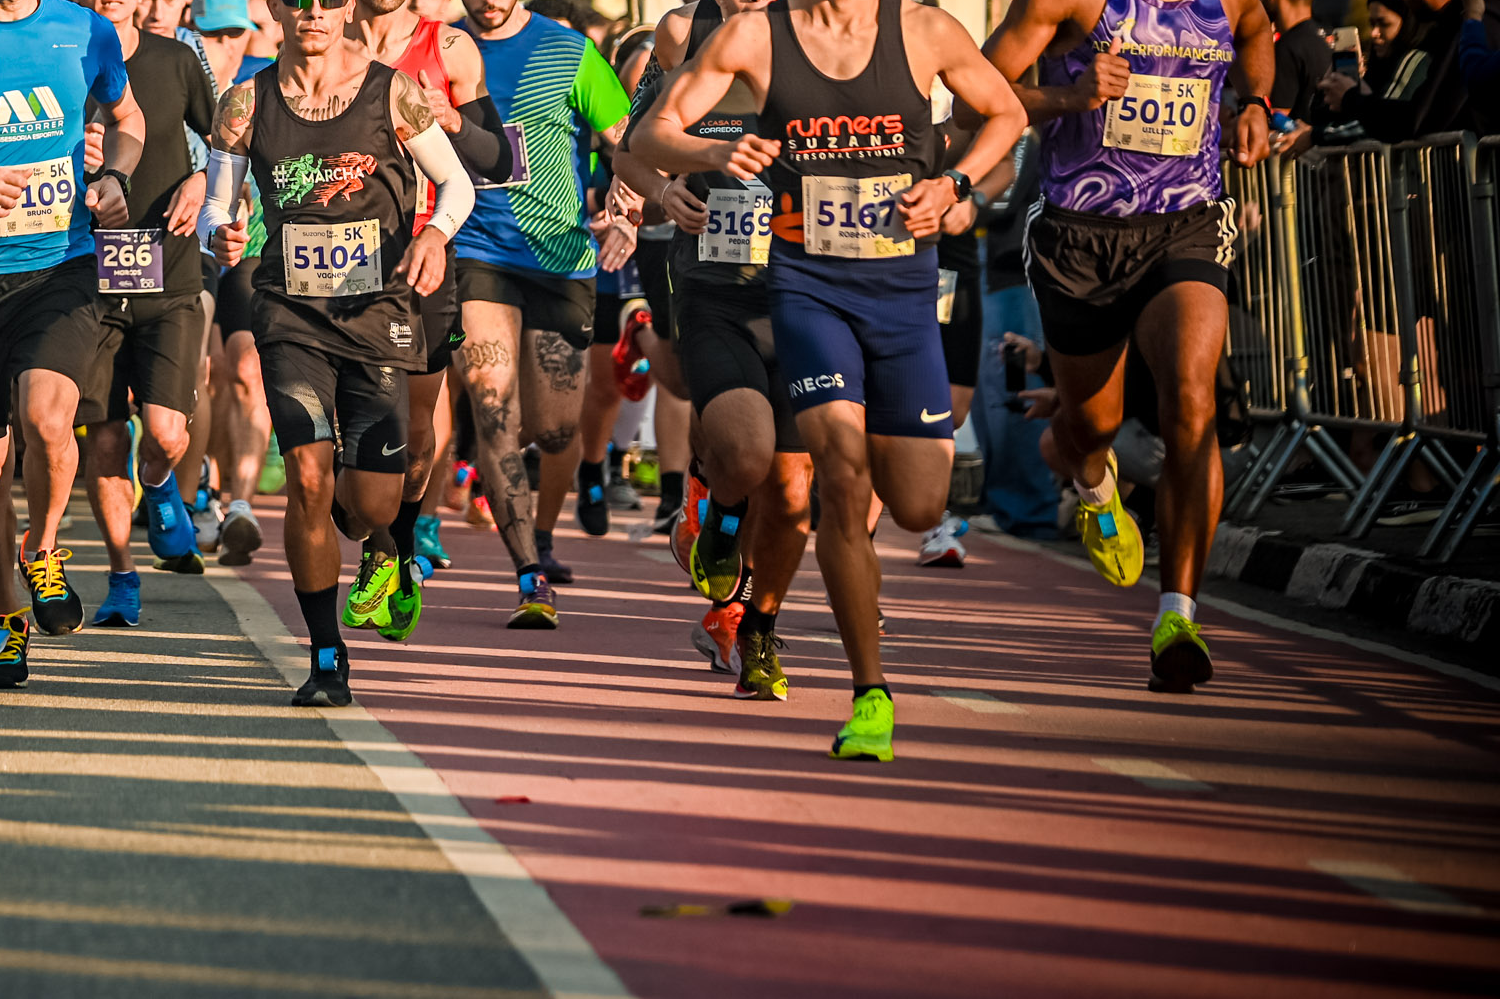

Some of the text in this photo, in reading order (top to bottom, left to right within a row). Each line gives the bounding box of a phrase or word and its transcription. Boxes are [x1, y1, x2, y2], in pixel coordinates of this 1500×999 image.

[1176, 83, 1195, 98] 5K
[1118, 95, 1197, 127] 5010
[699, 126, 743, 135] CORREDOR
[786, 114, 904, 137] runners
[32, 130, 64, 140] ESPORTIVA
[788, 133, 905, 150] SUZANO
[858, 146, 905, 158] STUDIO
[50, 162, 67, 178] 5K
[873, 181, 893, 198] 5K
[754, 195, 772, 208] 5K
[27, 208, 52, 216] BRUNO
[817, 199, 896, 229] 5167
[707, 209, 772, 236] 5169
[344, 226, 363, 241] 5K
[103, 244, 153, 267] 266
[294, 243, 368, 269] 5104
